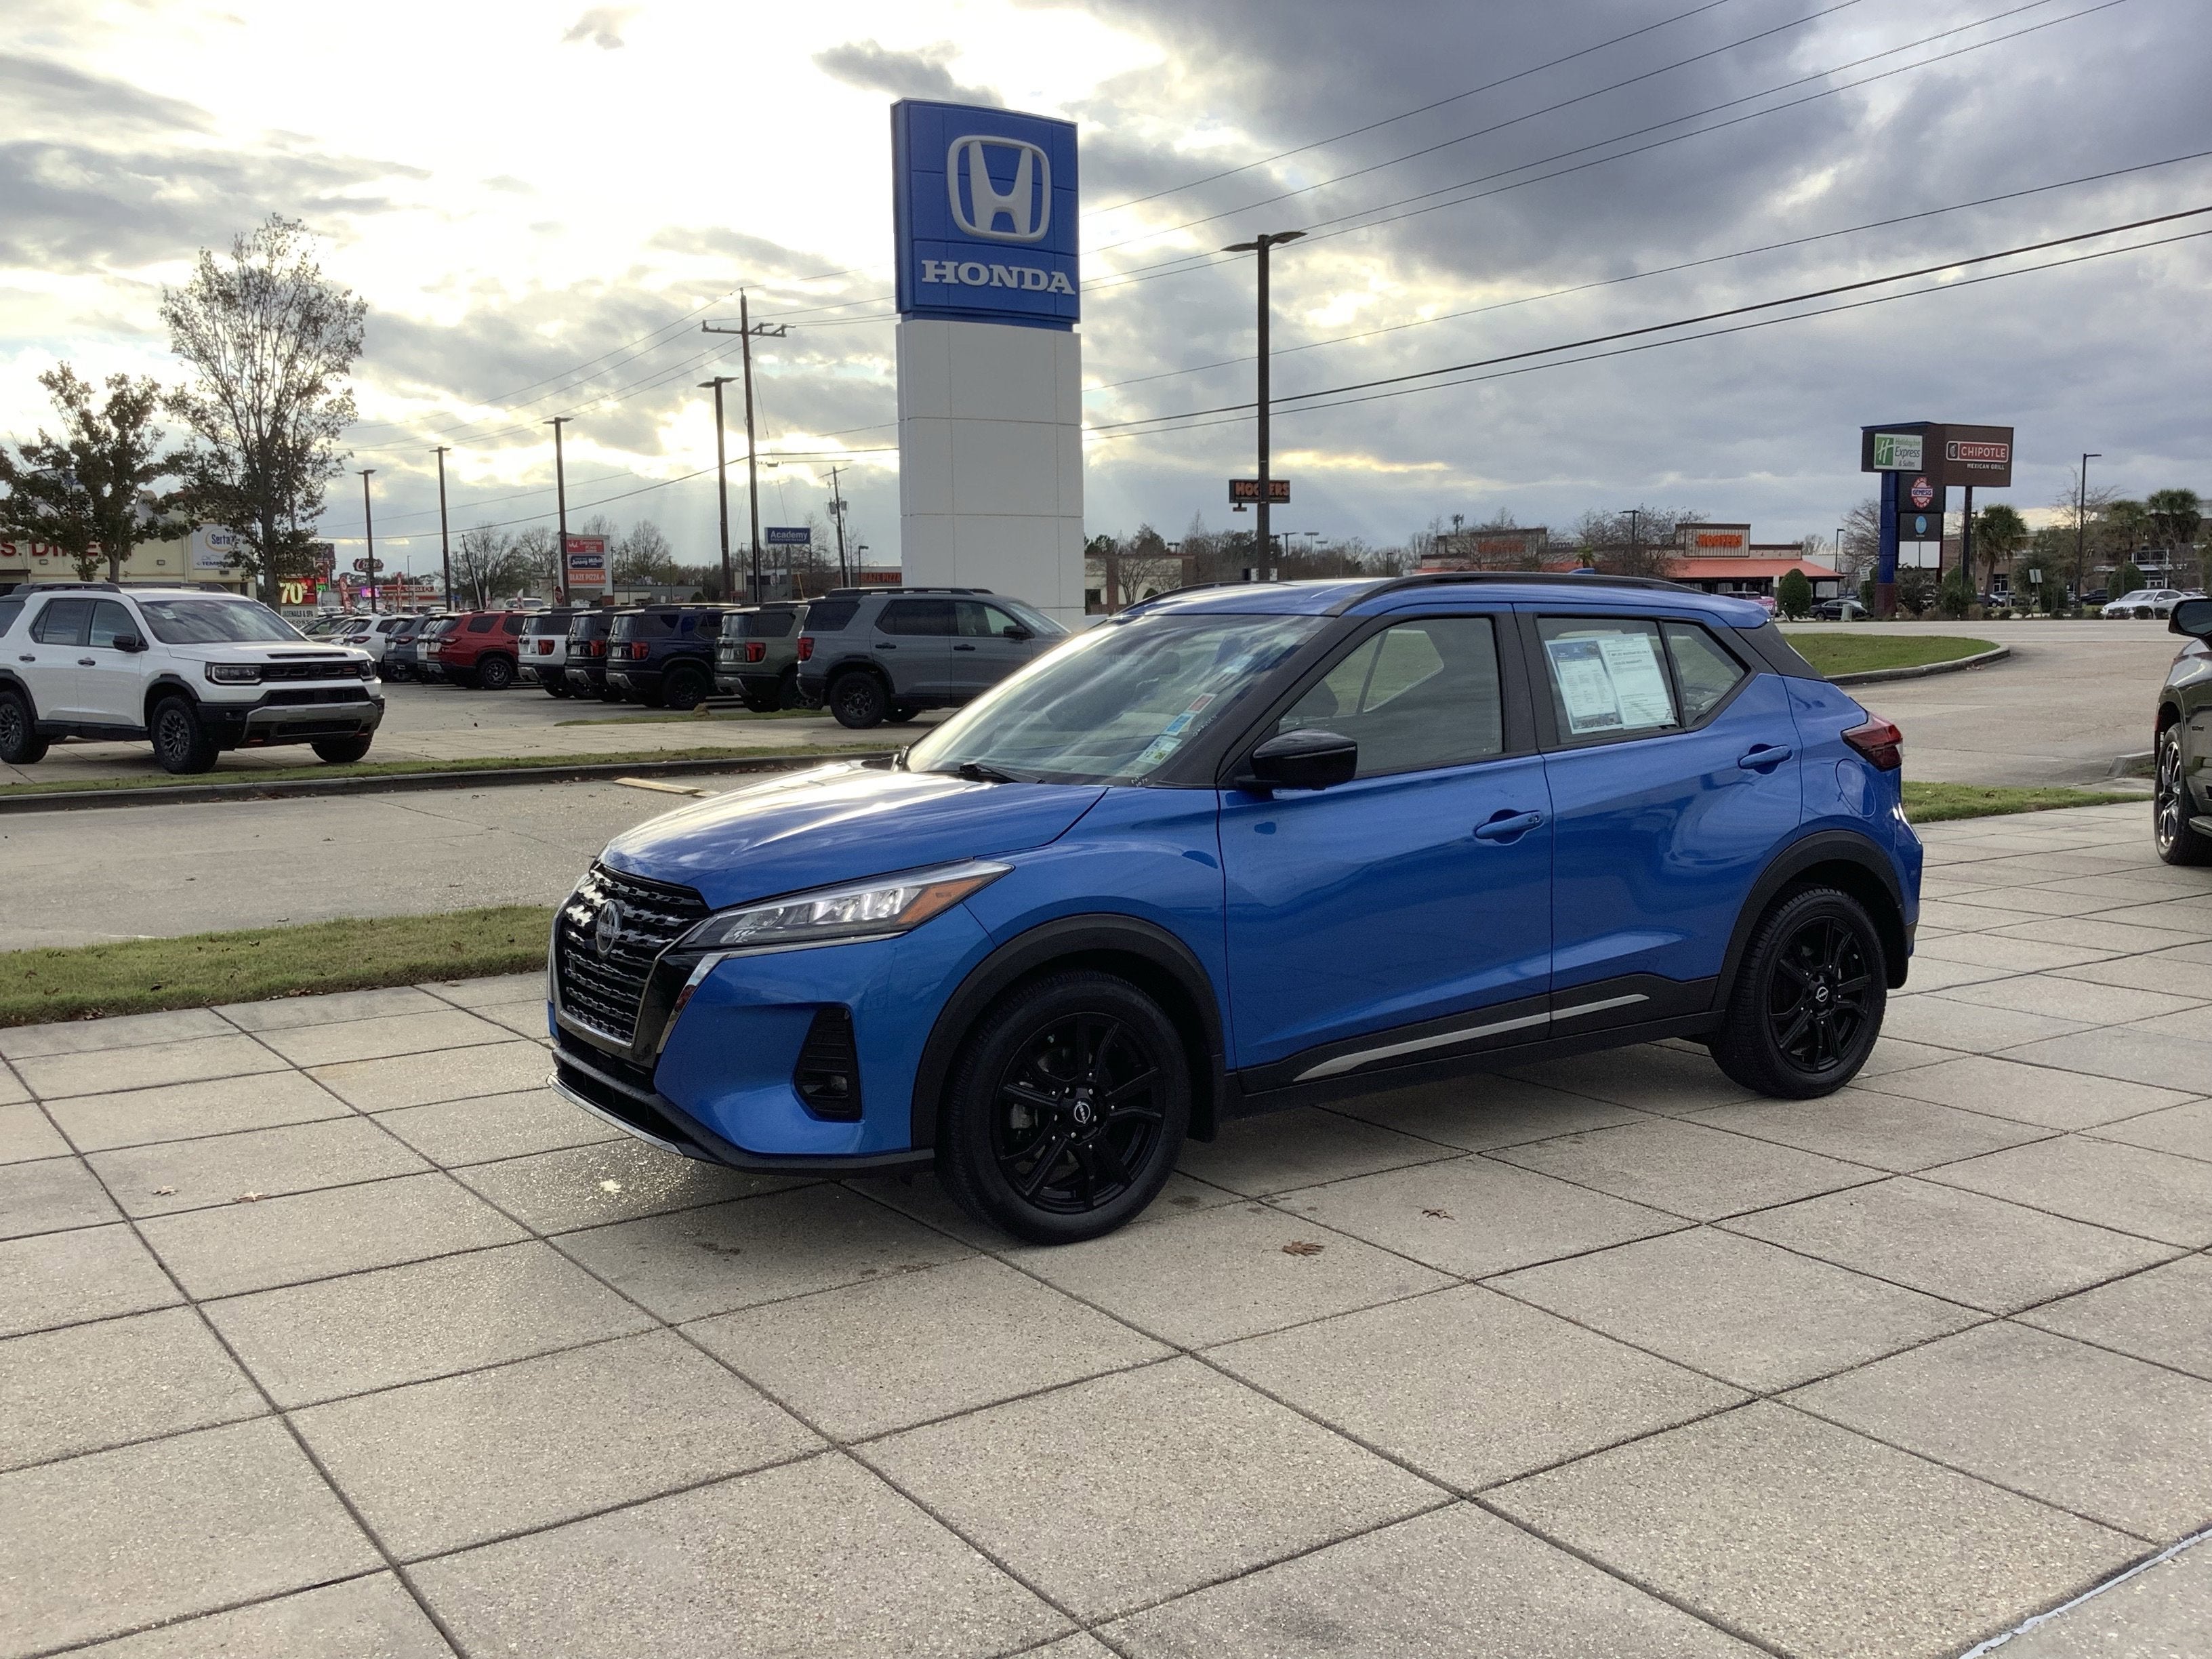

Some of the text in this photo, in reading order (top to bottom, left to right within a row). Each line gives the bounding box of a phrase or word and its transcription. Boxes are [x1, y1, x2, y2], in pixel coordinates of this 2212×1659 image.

[921, 260, 1076, 295] HONDA
[1895, 446, 1920, 459] Express
[1961, 446, 2006, 458] CHIPOTLE
[1235, 481, 1290, 496] HOERS
[211, 534, 230, 545] Serta
[770, 530, 808, 541] Academy
